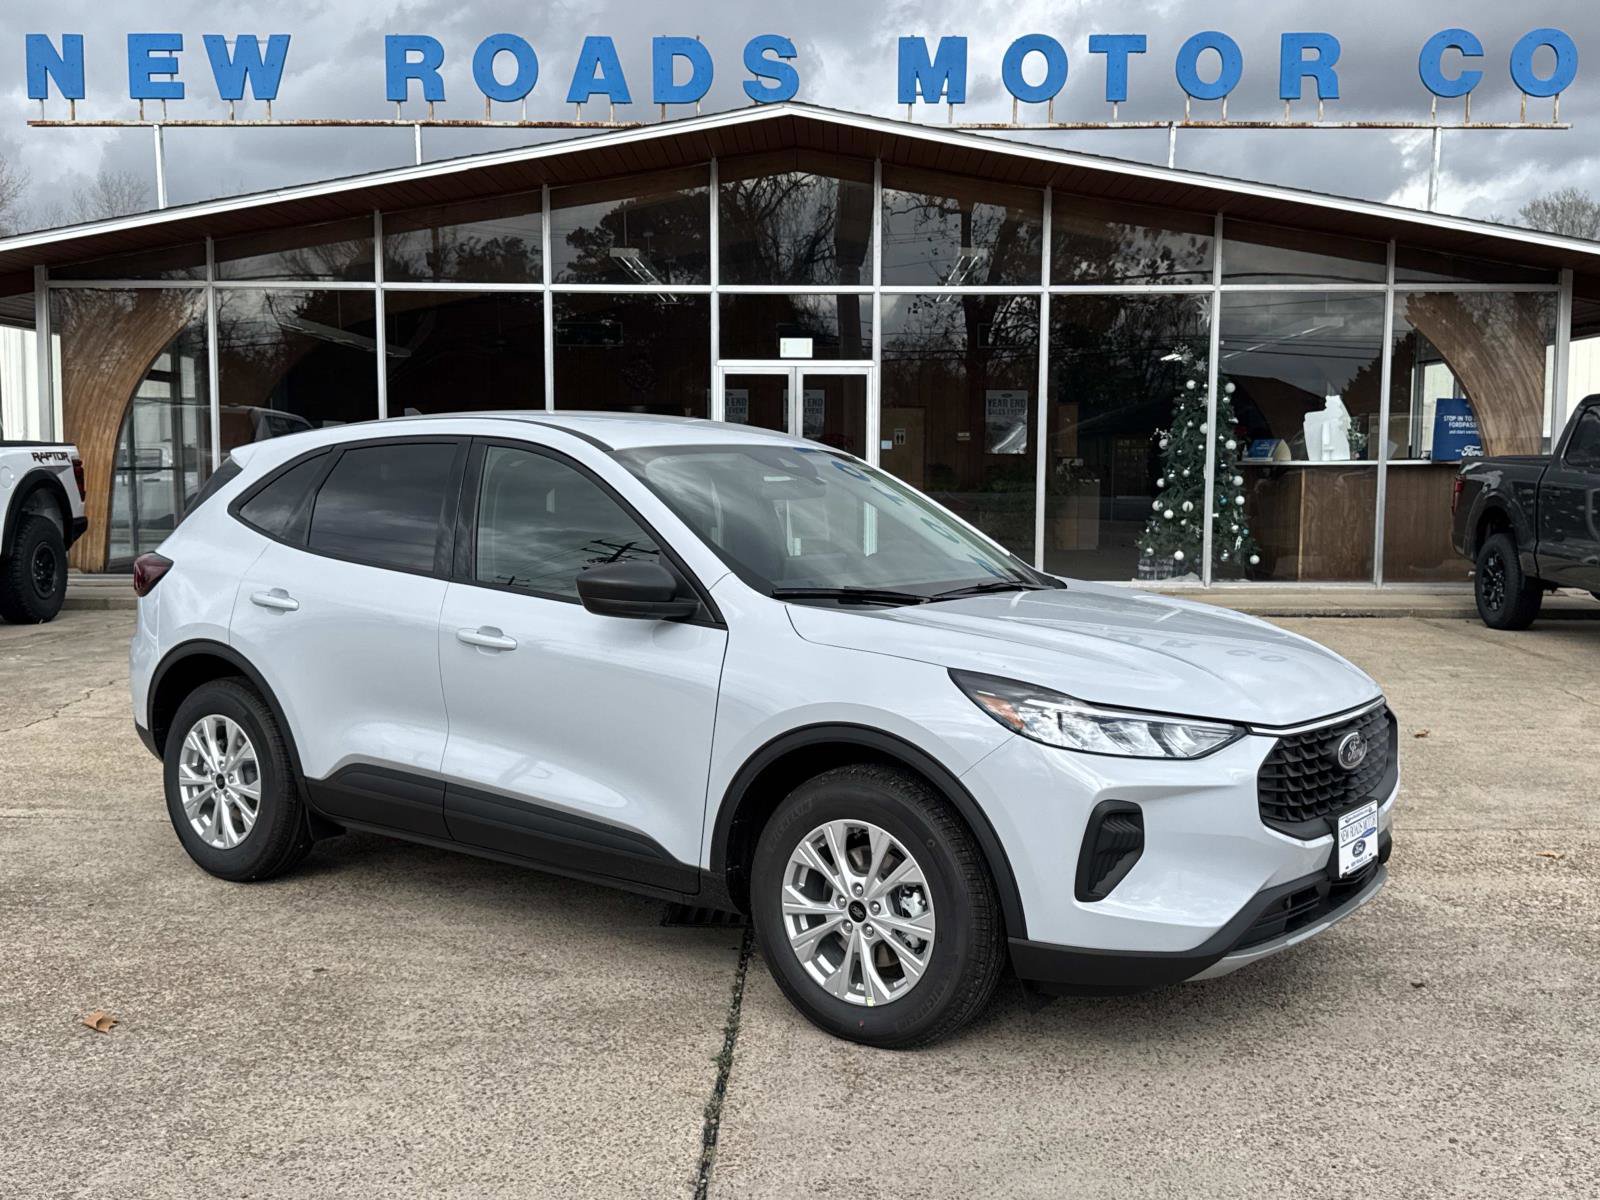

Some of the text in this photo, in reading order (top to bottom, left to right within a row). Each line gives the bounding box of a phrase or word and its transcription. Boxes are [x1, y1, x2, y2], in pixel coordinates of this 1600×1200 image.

[26, 29, 1577, 103] NEW ROADS MOTOR CO
[1010, 399, 1026, 408] END
[31, 452, 71, 464] RAPTOR
